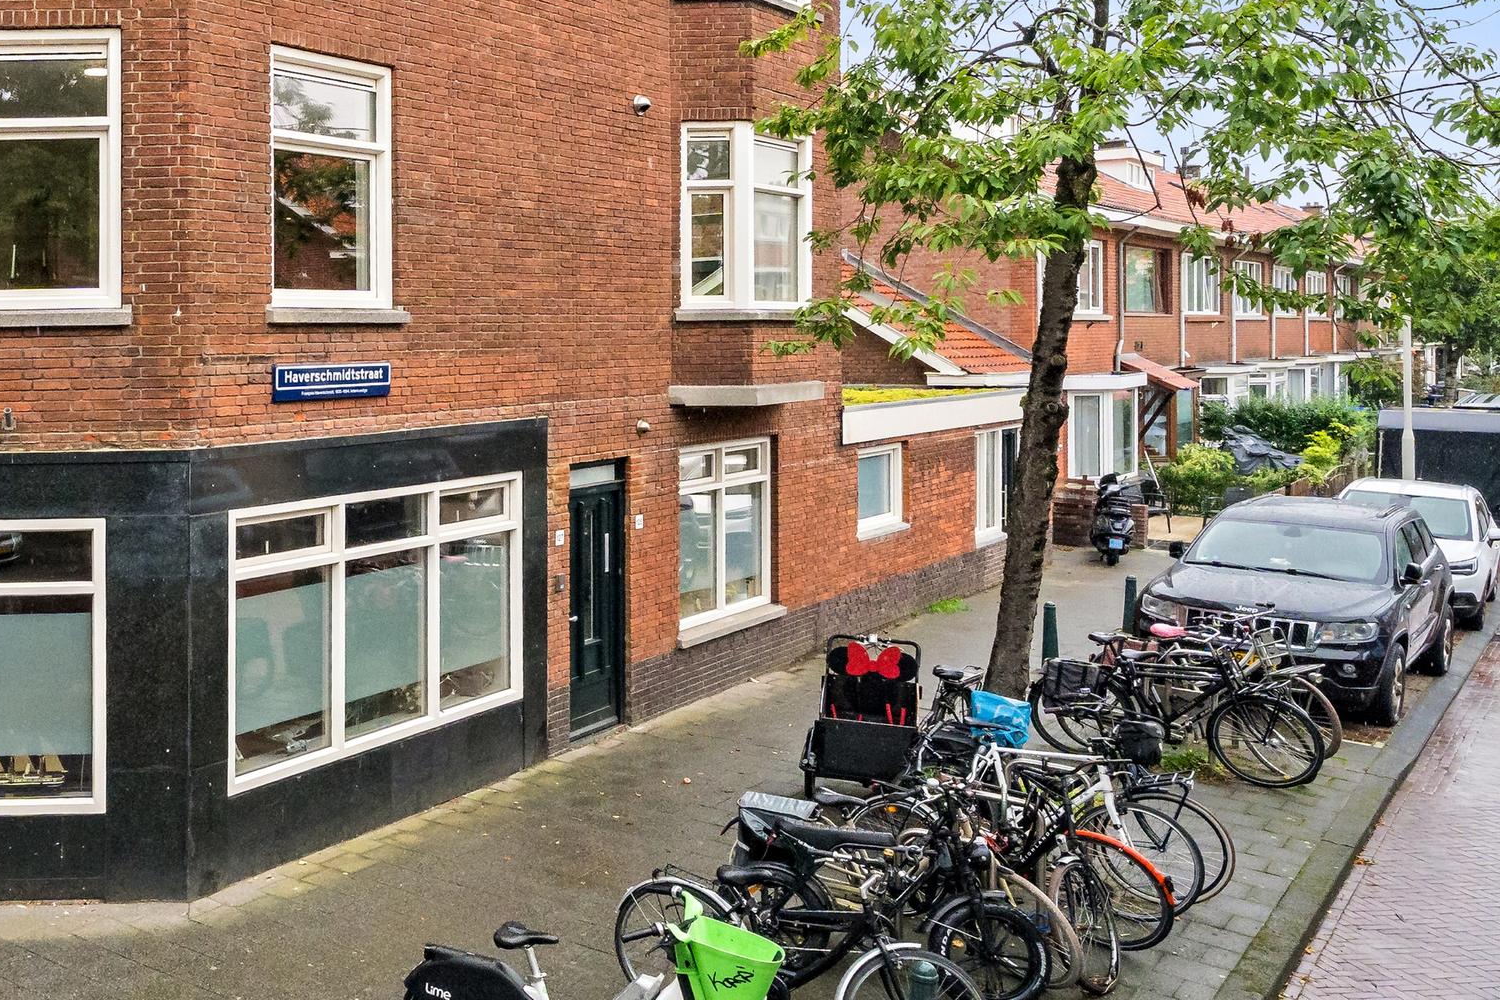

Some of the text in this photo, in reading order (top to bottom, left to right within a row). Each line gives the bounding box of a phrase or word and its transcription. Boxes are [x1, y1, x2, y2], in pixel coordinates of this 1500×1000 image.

[284, 367, 384, 384] Haverschmidtstraat
[1235, 604, 1259, 614] Jeep
[425, 982, 452, 1000] Lime
